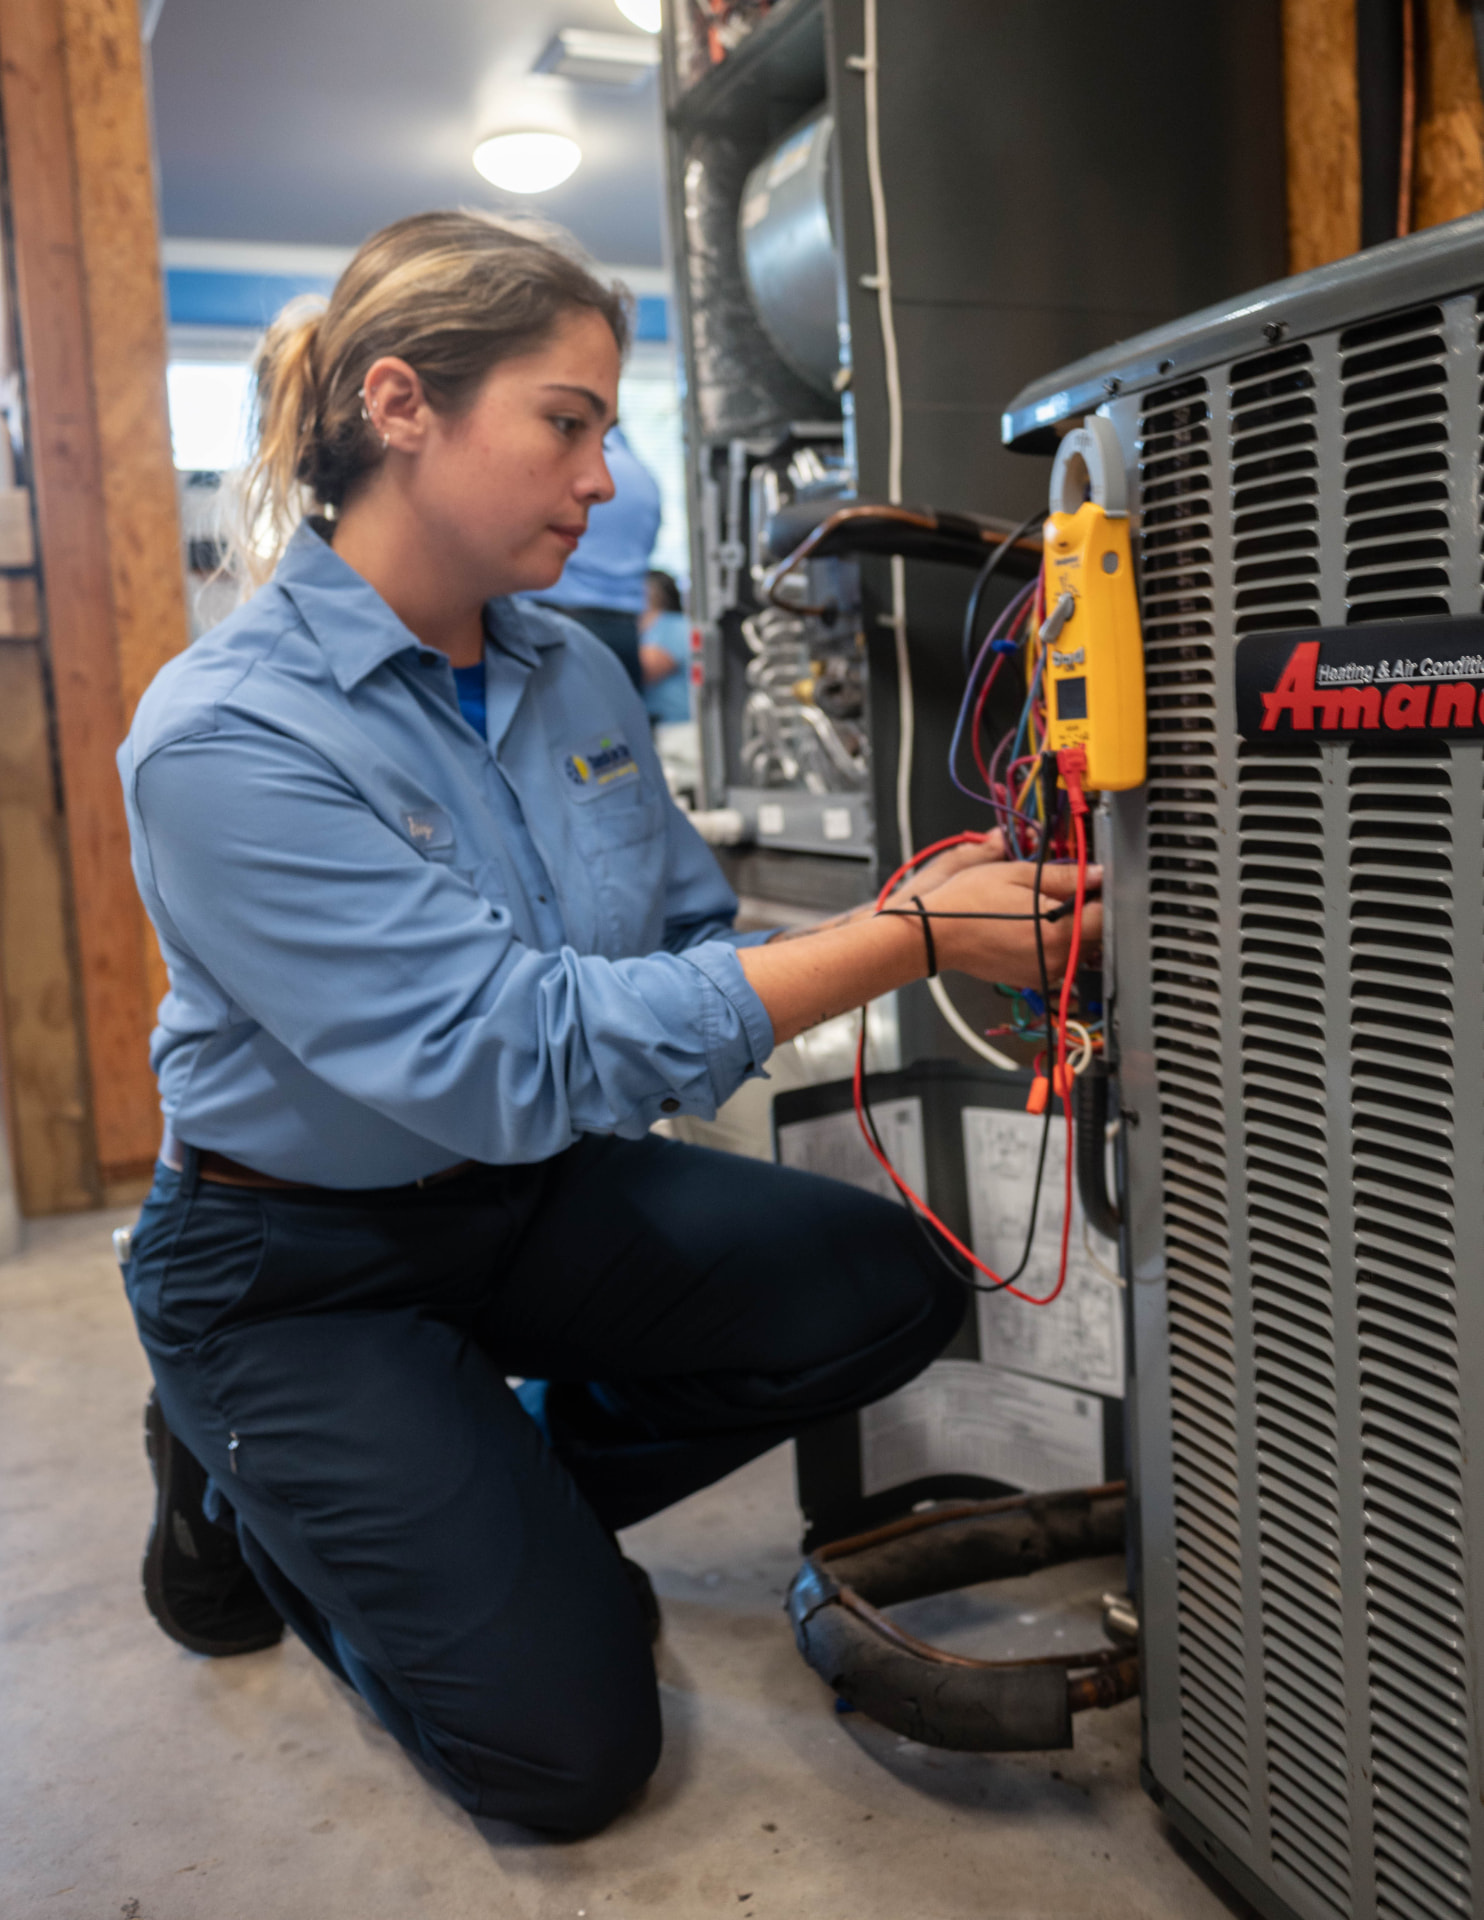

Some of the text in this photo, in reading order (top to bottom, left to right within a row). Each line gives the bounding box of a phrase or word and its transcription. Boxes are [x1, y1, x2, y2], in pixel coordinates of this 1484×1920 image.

[1259, 641, 1484, 731] Aman
[1317, 662, 1375, 684] Heating
[1377, 659, 1391, 679] &
[1391, 658, 1418, 678] Air
